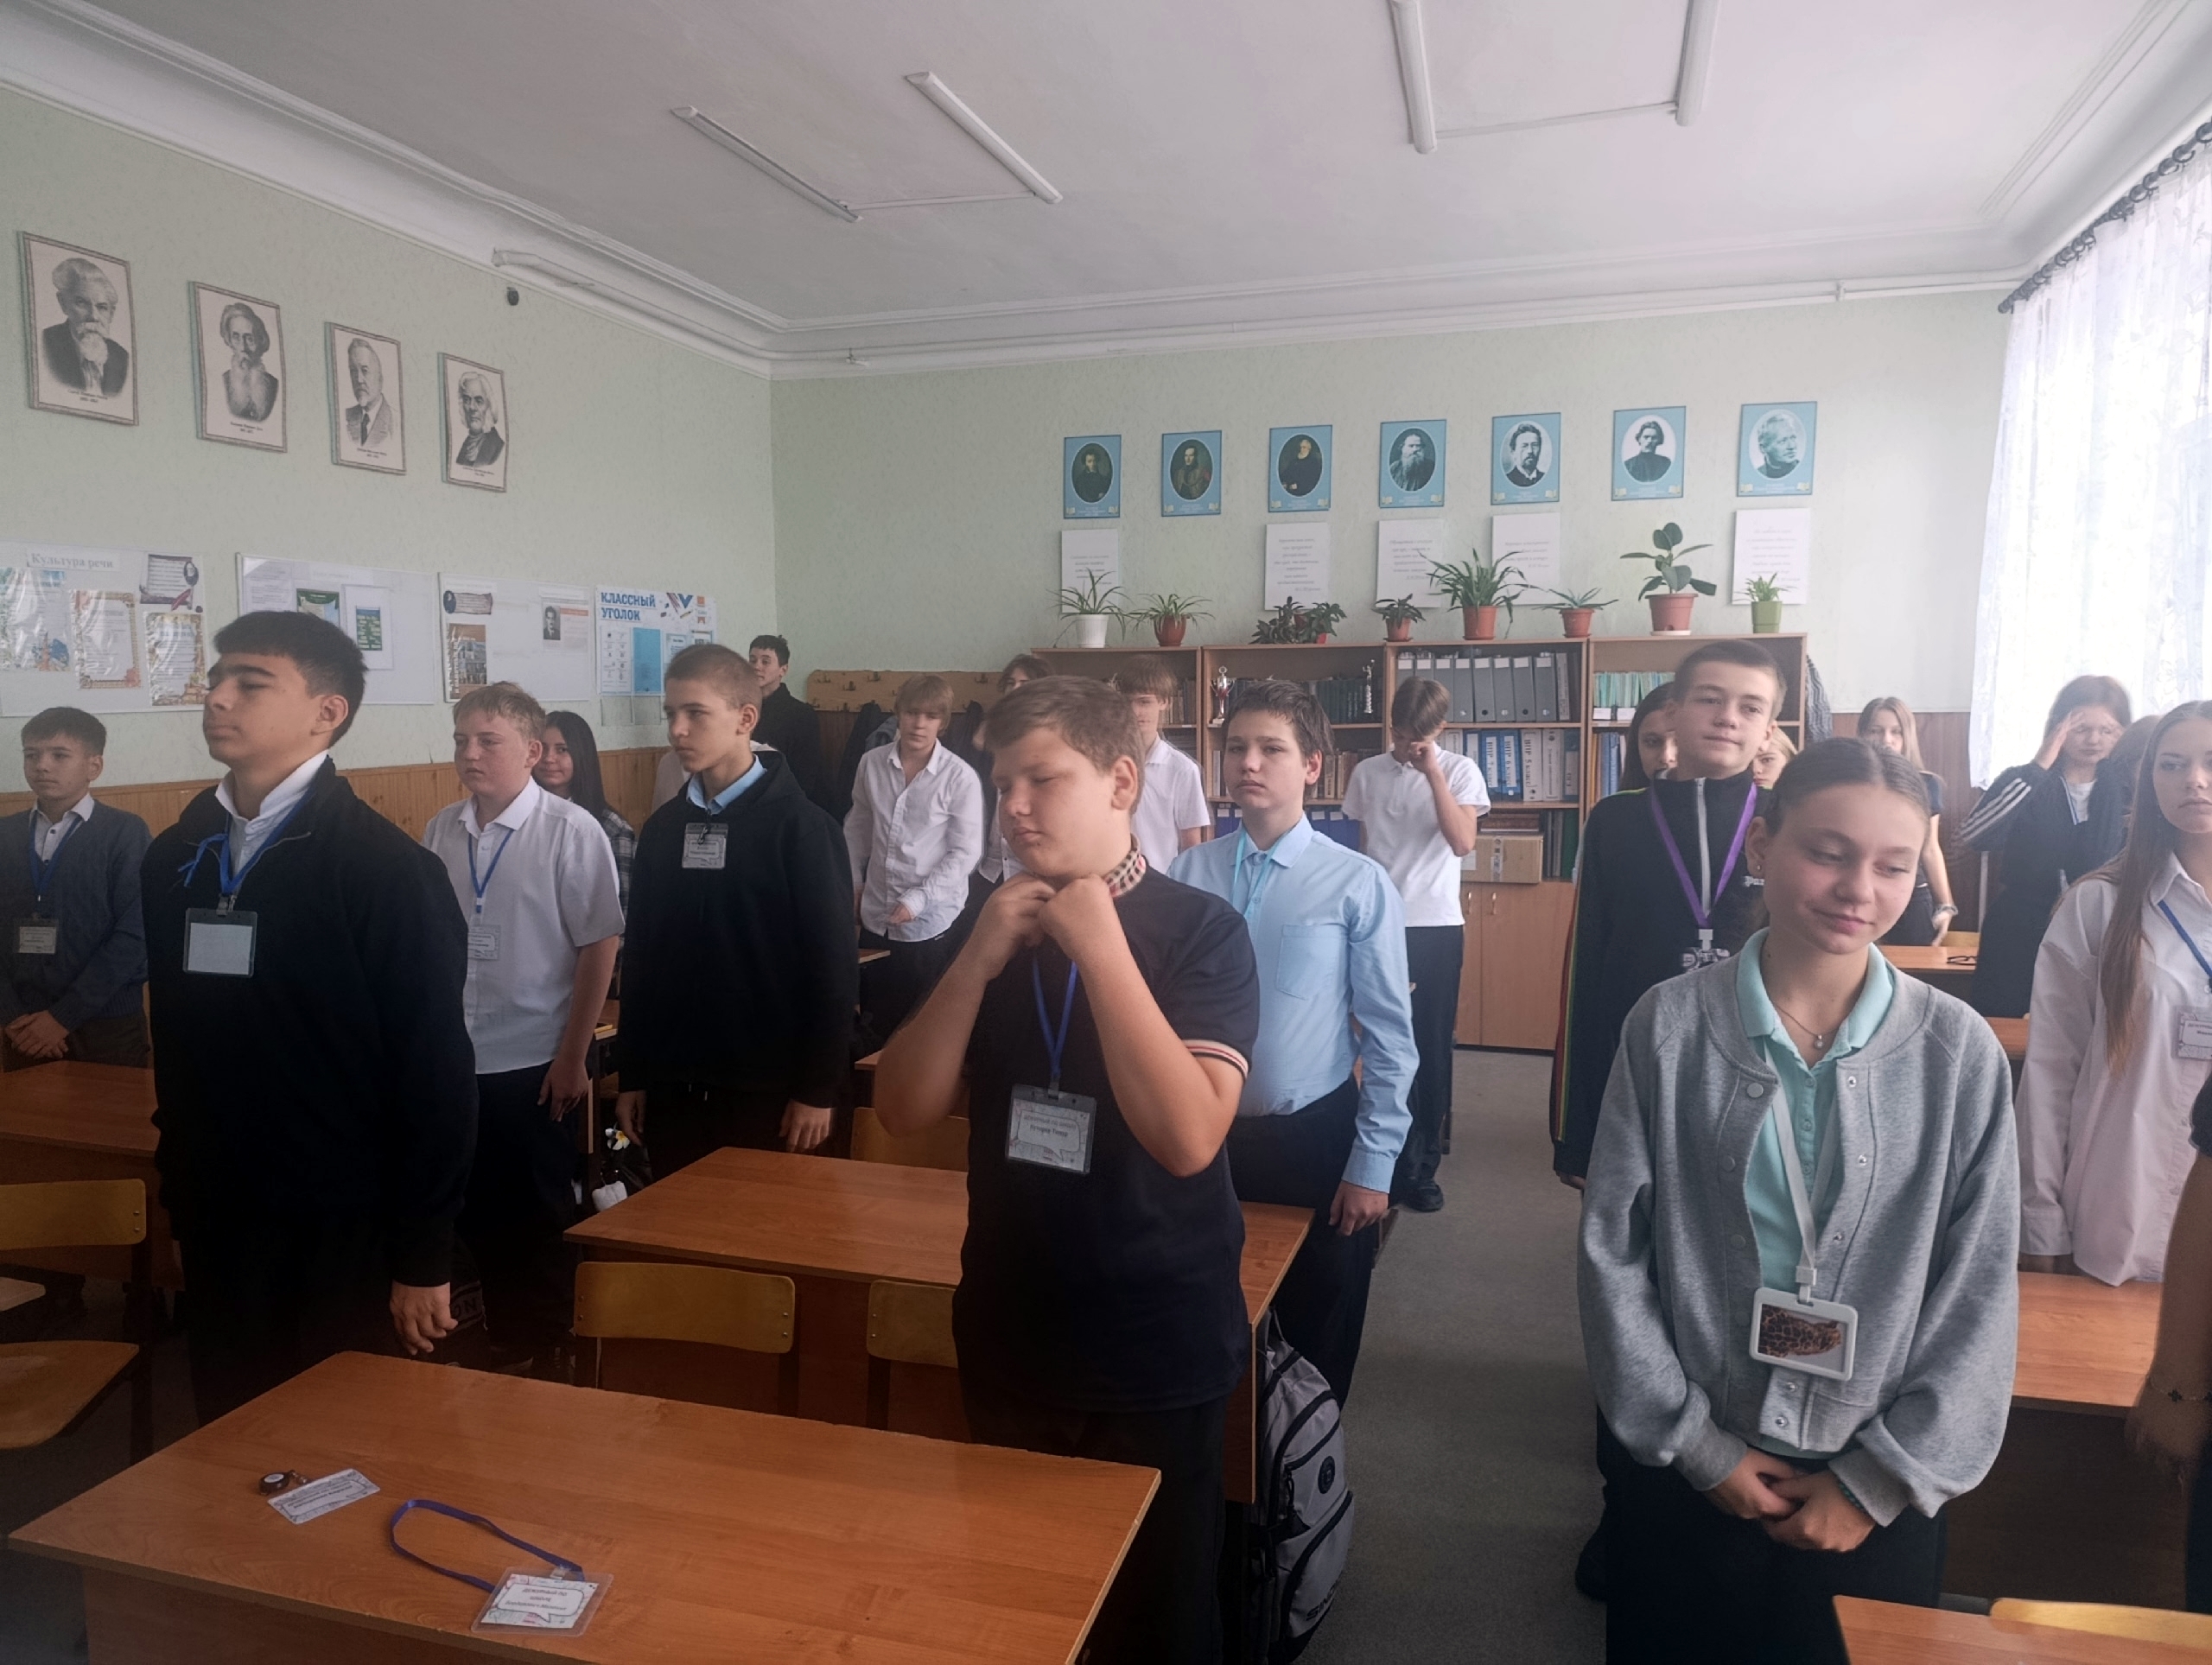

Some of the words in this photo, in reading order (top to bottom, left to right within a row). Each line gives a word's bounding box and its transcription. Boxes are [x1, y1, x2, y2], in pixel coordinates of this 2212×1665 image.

[31, 553, 85, 569] Культура
[88, 556, 114, 569] речи
[601, 592, 657, 607] КЛАССНЫЙ
[601, 607, 641, 621] УГОЛОК
